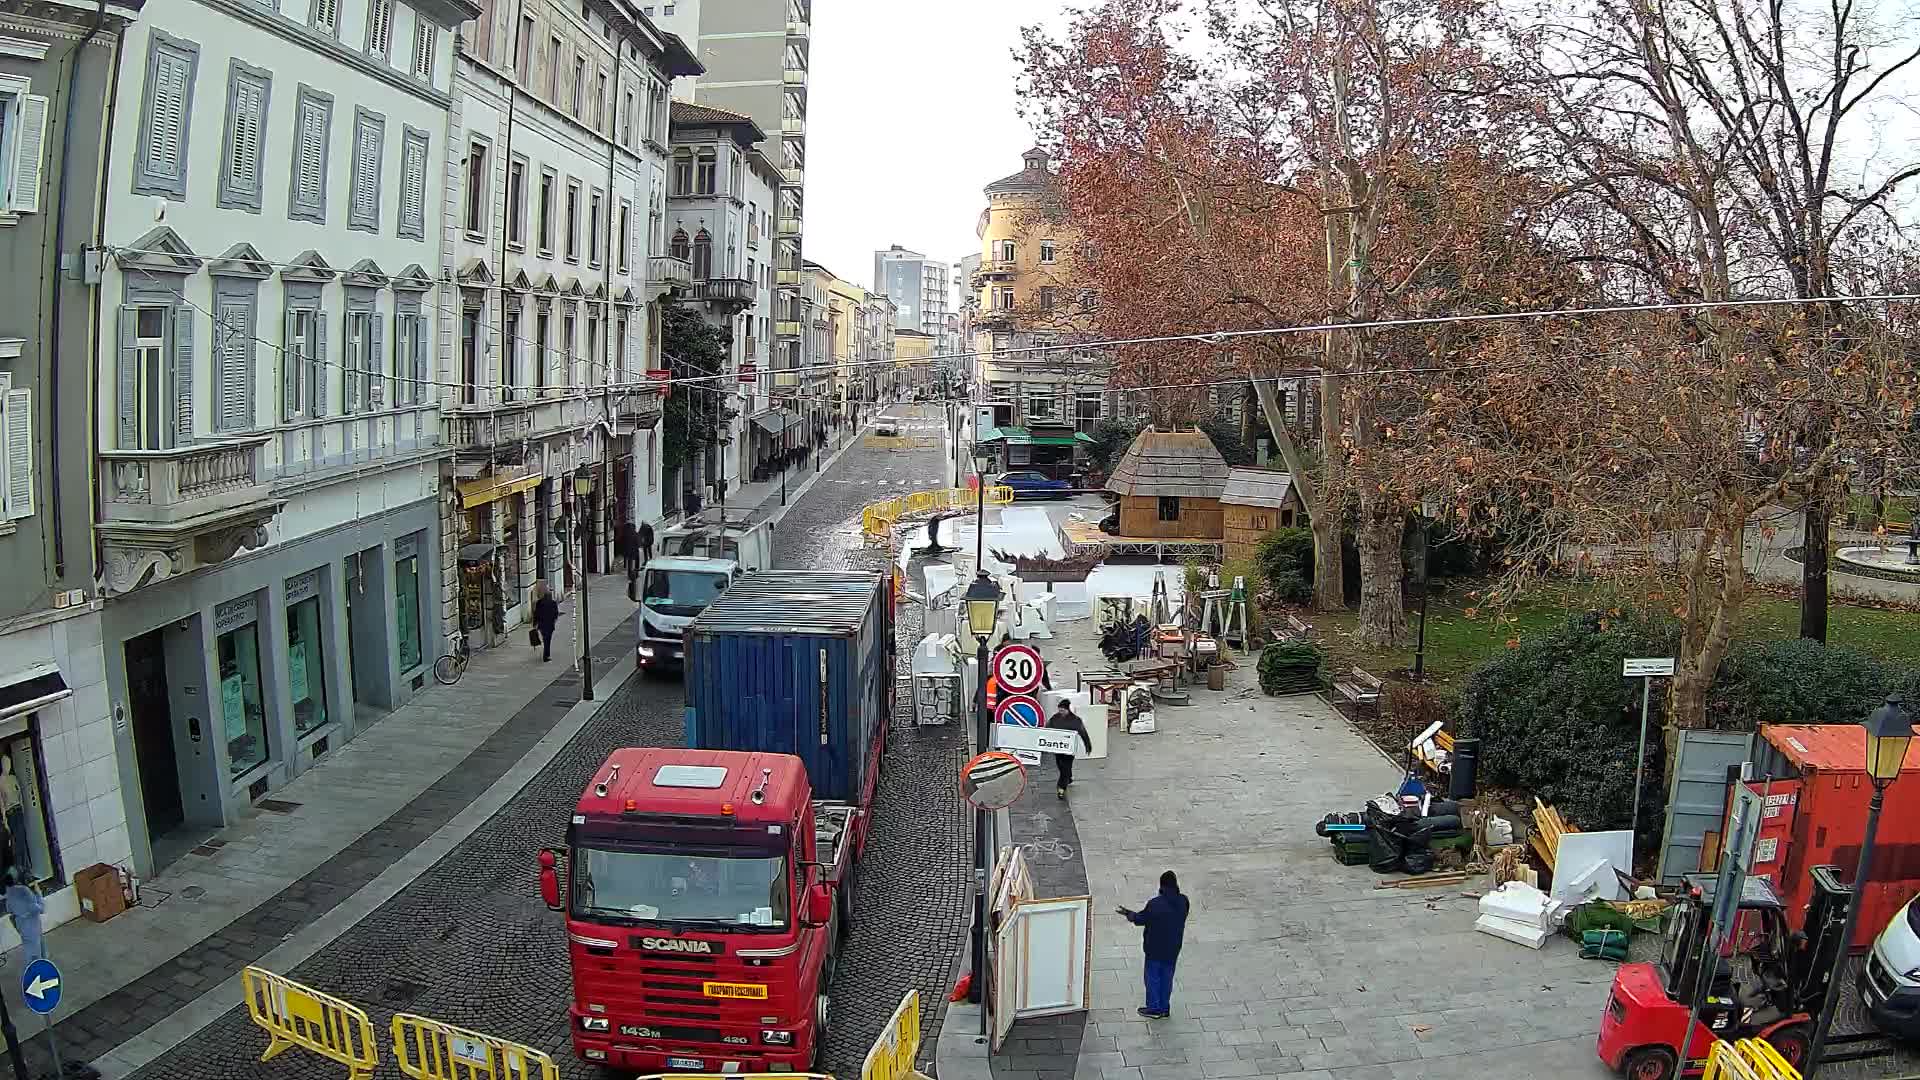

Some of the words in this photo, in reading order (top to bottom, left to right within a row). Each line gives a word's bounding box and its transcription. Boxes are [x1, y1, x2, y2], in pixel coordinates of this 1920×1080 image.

[1005, 658, 1032, 681] 30
[1039, 738, 1070, 749] Dante
[642, 937, 711, 953] SCANIA
[722, 1035, 748, 1045] 420
